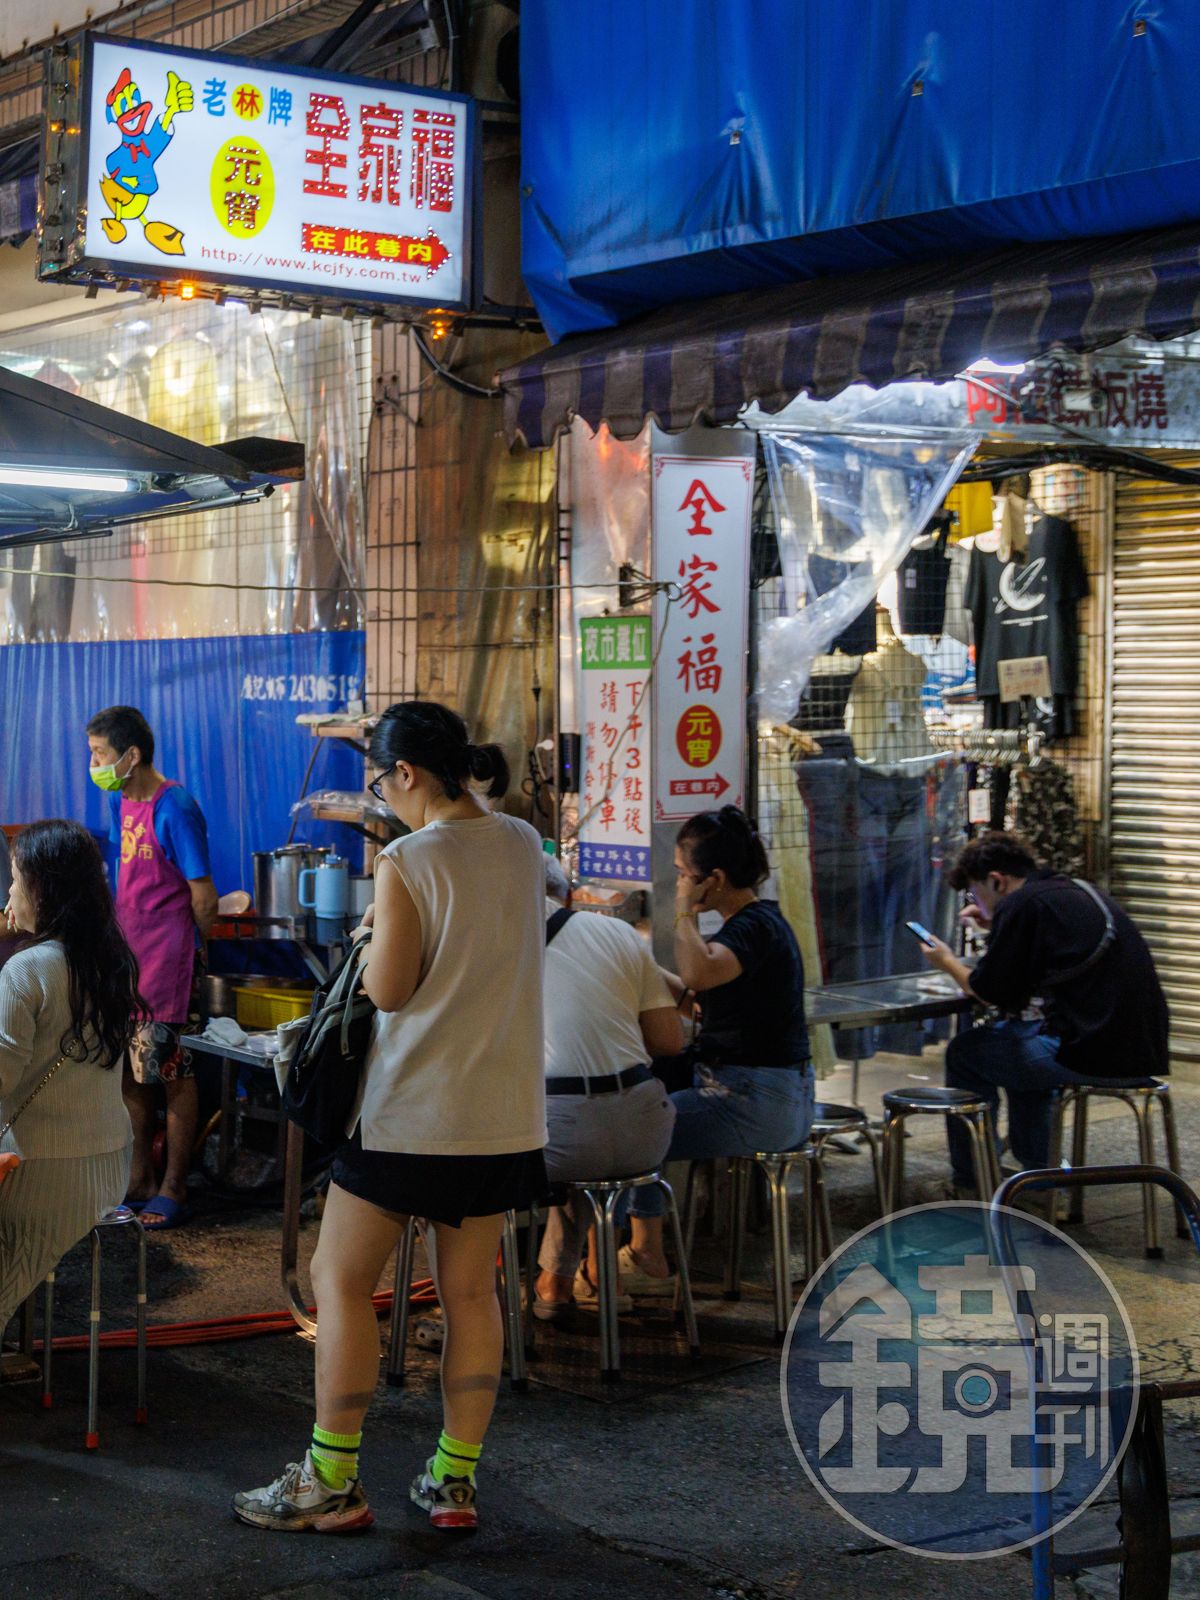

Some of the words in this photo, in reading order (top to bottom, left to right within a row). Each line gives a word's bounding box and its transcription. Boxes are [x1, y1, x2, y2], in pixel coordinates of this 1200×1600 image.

[202, 76, 293, 127] 老林牌
[303, 92, 456, 213] 全家福
[224, 145, 262, 231] 元宵
[201, 246, 422, 285] http://www.kcjfy.com.tw
[310, 230, 432, 263] 在此巷內
[676, 479, 726, 694] 全家福
[584, 624, 647, 663] 夜市攤位
[598, 681, 618, 832] 請勿停車
[623, 681, 644, 835] 下午3點後
[685, 712, 712, 763] 元宵
[673, 782, 720, 794] 在巷內
